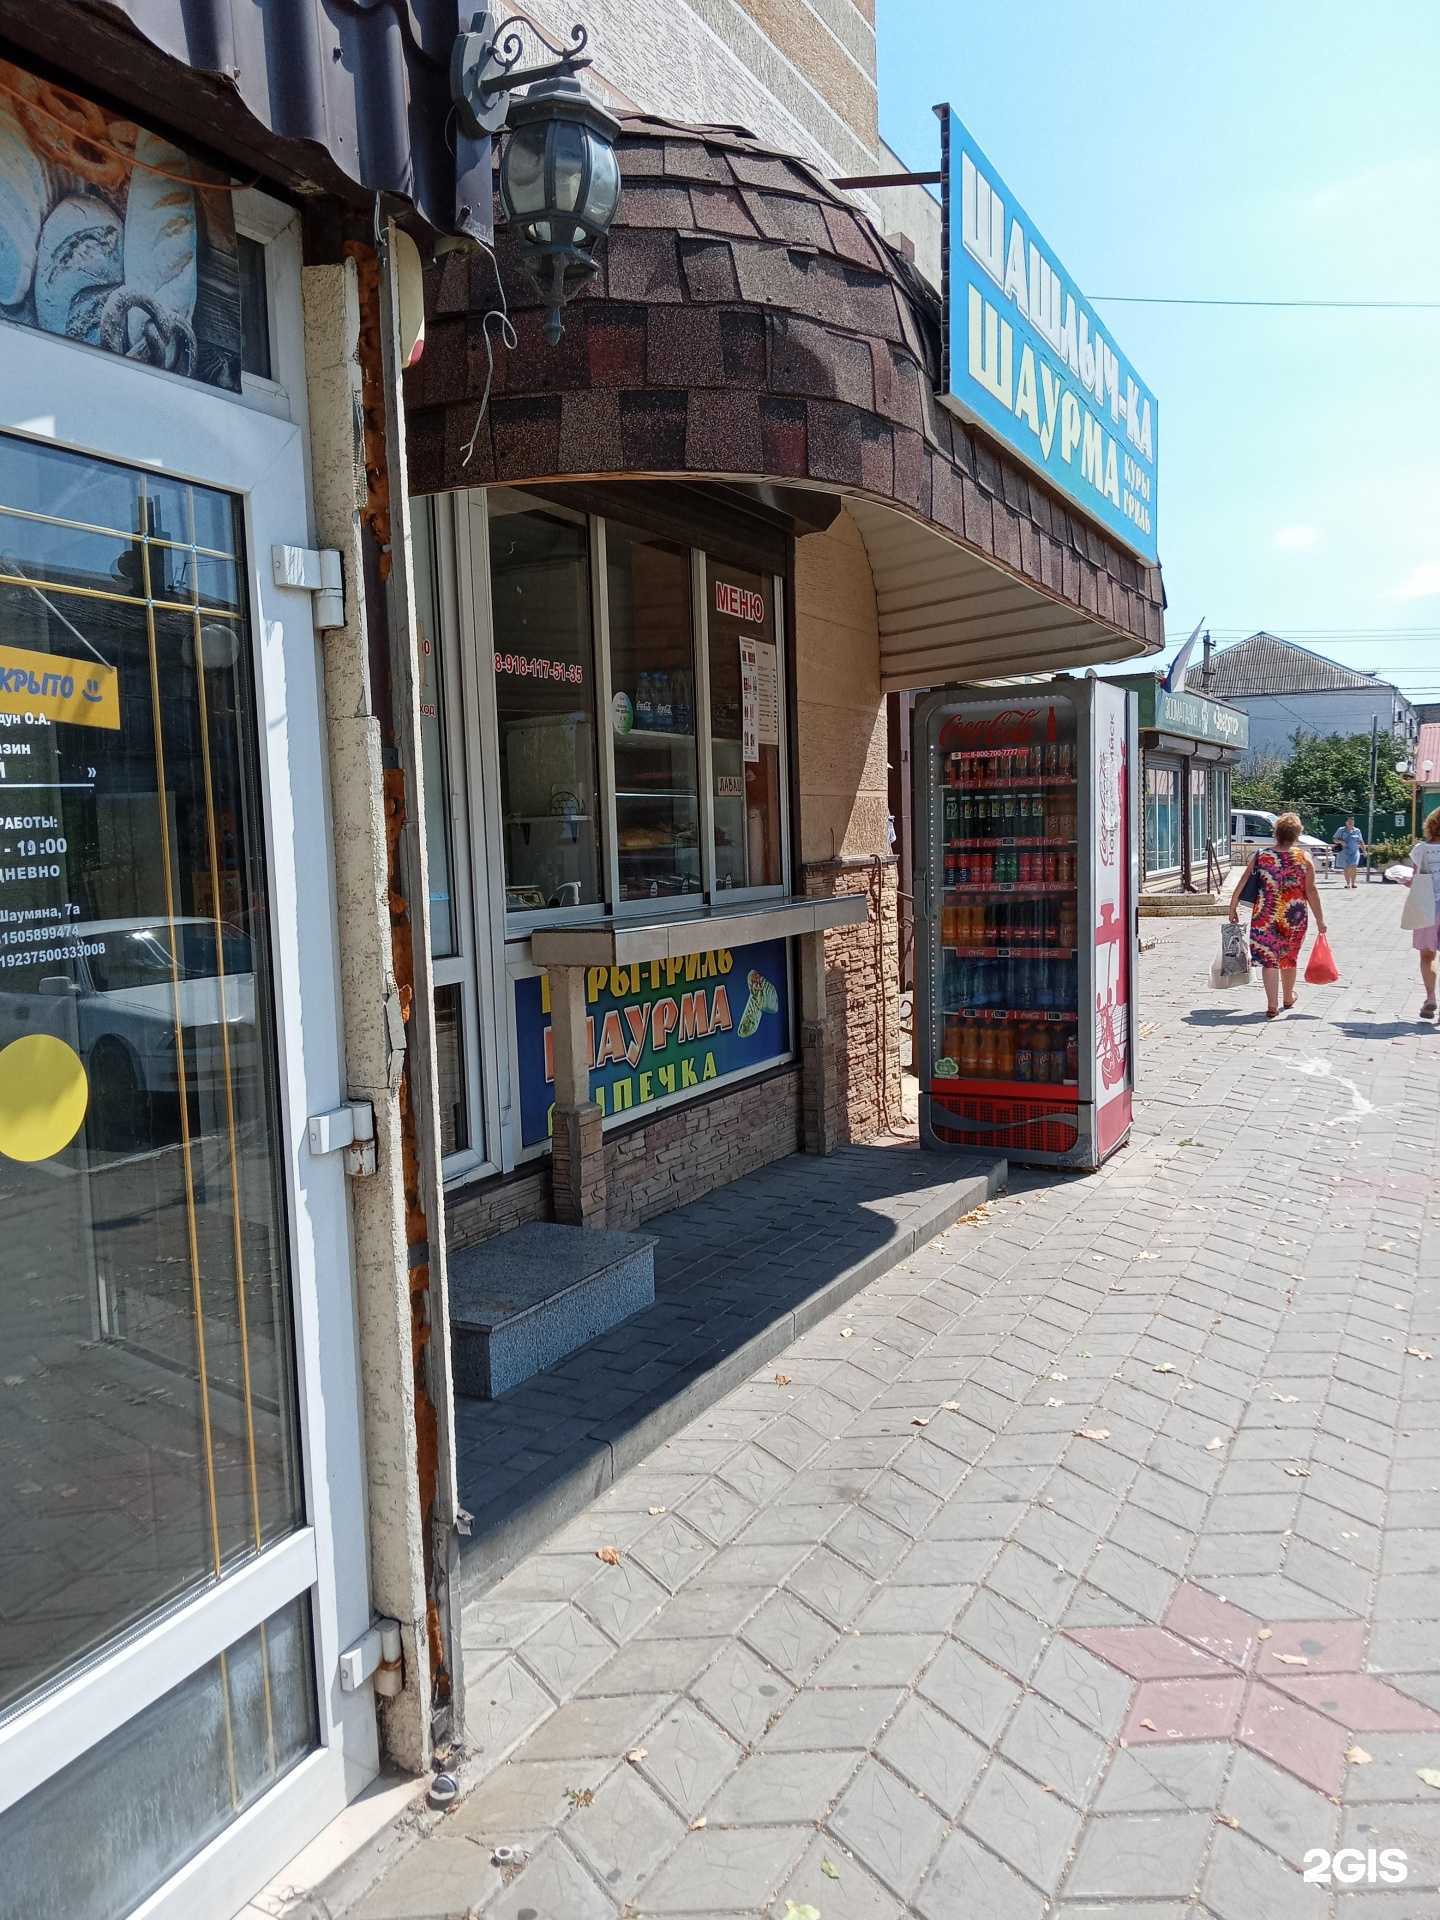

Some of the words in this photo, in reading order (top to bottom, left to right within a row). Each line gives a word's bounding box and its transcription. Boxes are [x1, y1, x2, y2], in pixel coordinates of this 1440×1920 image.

[962, 150, 1152, 463] ШАШЛЫЧ-КА
[968, 282, 1120, 510] ШАУРМА
[1124, 454, 1150, 502] КУРЫ
[1123, 488, 1150, 535] ГРИЛЬ
[715, 580, 765, 623] МЕНЮ
[493, 652, 583, 684] 8-918-117-51-35
[24, 711, 51, 726] О.А.
[17, 837, 67, 856] 19:00
[64, 902, 81, 916] 7а
[0, 924, 80, 945] 1505899474
